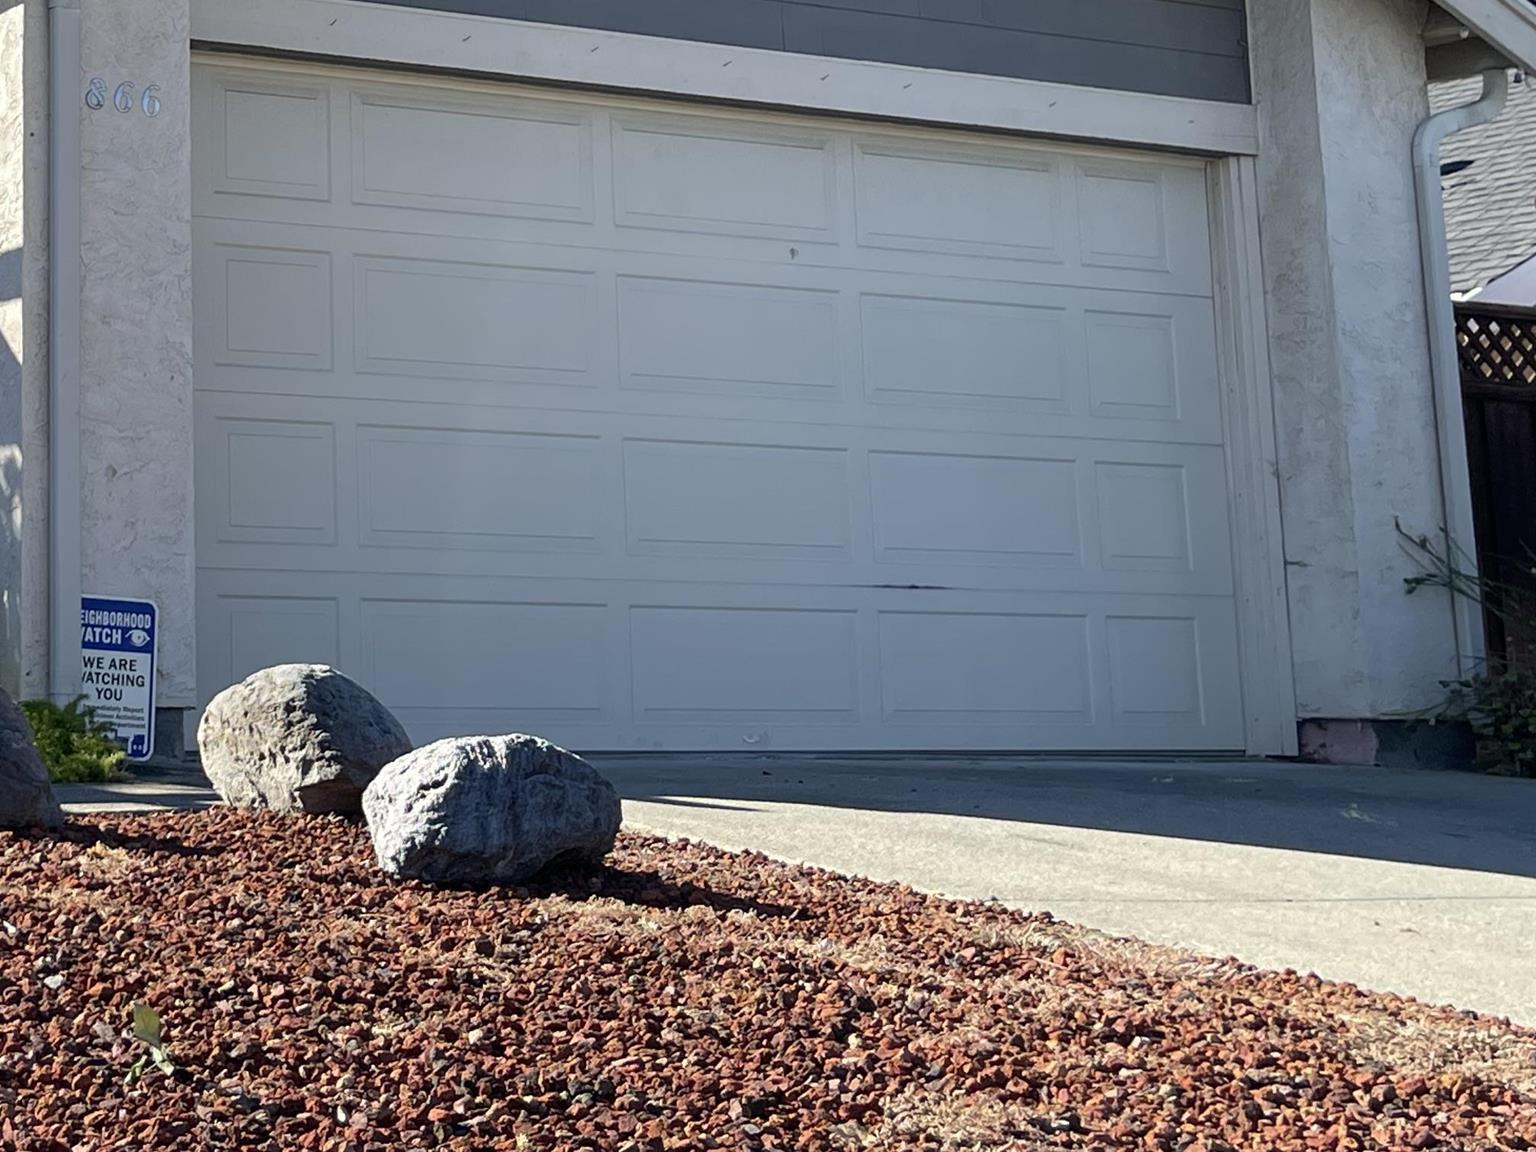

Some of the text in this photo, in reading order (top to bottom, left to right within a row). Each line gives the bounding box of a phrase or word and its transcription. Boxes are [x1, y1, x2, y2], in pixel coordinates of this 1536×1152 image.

[85, 77, 161, 118] 866
[81, 609, 151, 629] EIGHBORHOOD
[82, 656, 137, 672] WE ARE
[96, 688, 123, 701] YOU
